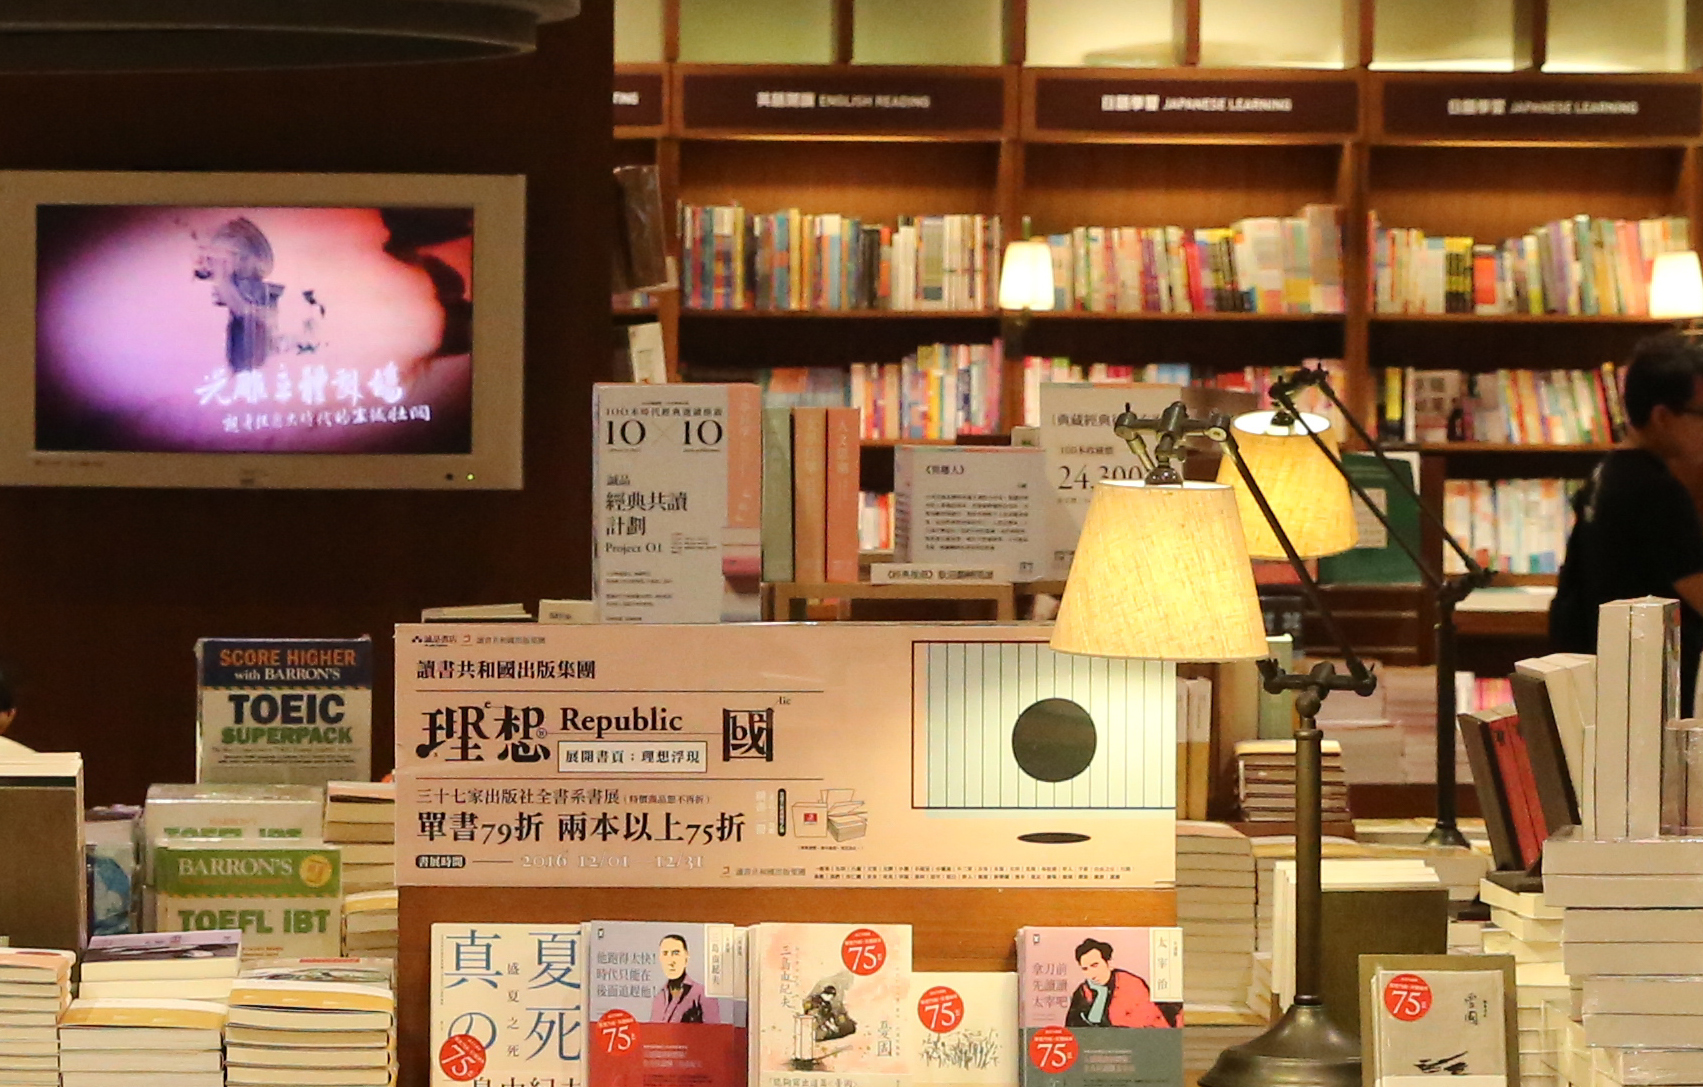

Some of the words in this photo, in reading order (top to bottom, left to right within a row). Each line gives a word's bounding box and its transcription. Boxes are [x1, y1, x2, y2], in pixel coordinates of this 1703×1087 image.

[606, 419, 646, 446] 10
[683, 419, 723, 446] 10
[606, 491, 688, 512] 經典共讀
[606, 516, 646, 536] 計劃
[605, 542, 641, 555] Project
[219, 649, 280, 667] SCORE
[286, 648, 357, 666] HIGHER
[234, 669, 260, 680] with
[264, 667, 341, 681] BARRON'S
[416, 660, 596, 680] 讀書共和國出版集團
[227, 693, 346, 725] TOEIC
[560, 706, 683, 739] Republic
[221, 726, 353, 745] SUPERPACK
[565, 750, 701, 764] 展開書頁：理想浮現
[415, 787, 620, 805] 三十七家出版社全書系書展
[416, 811, 545, 845] 單書79折
[558, 812, 746, 845] 兩本以上75折
[178, 857, 293, 877] BARRON'S
[521, 855, 568, 868] 2016
[178, 909, 274, 934] TOEFL
[284, 909, 331, 934] IBT
[1157, 936, 1168, 991] 太宰治
[506, 962, 520, 1058] 盛夏之死
